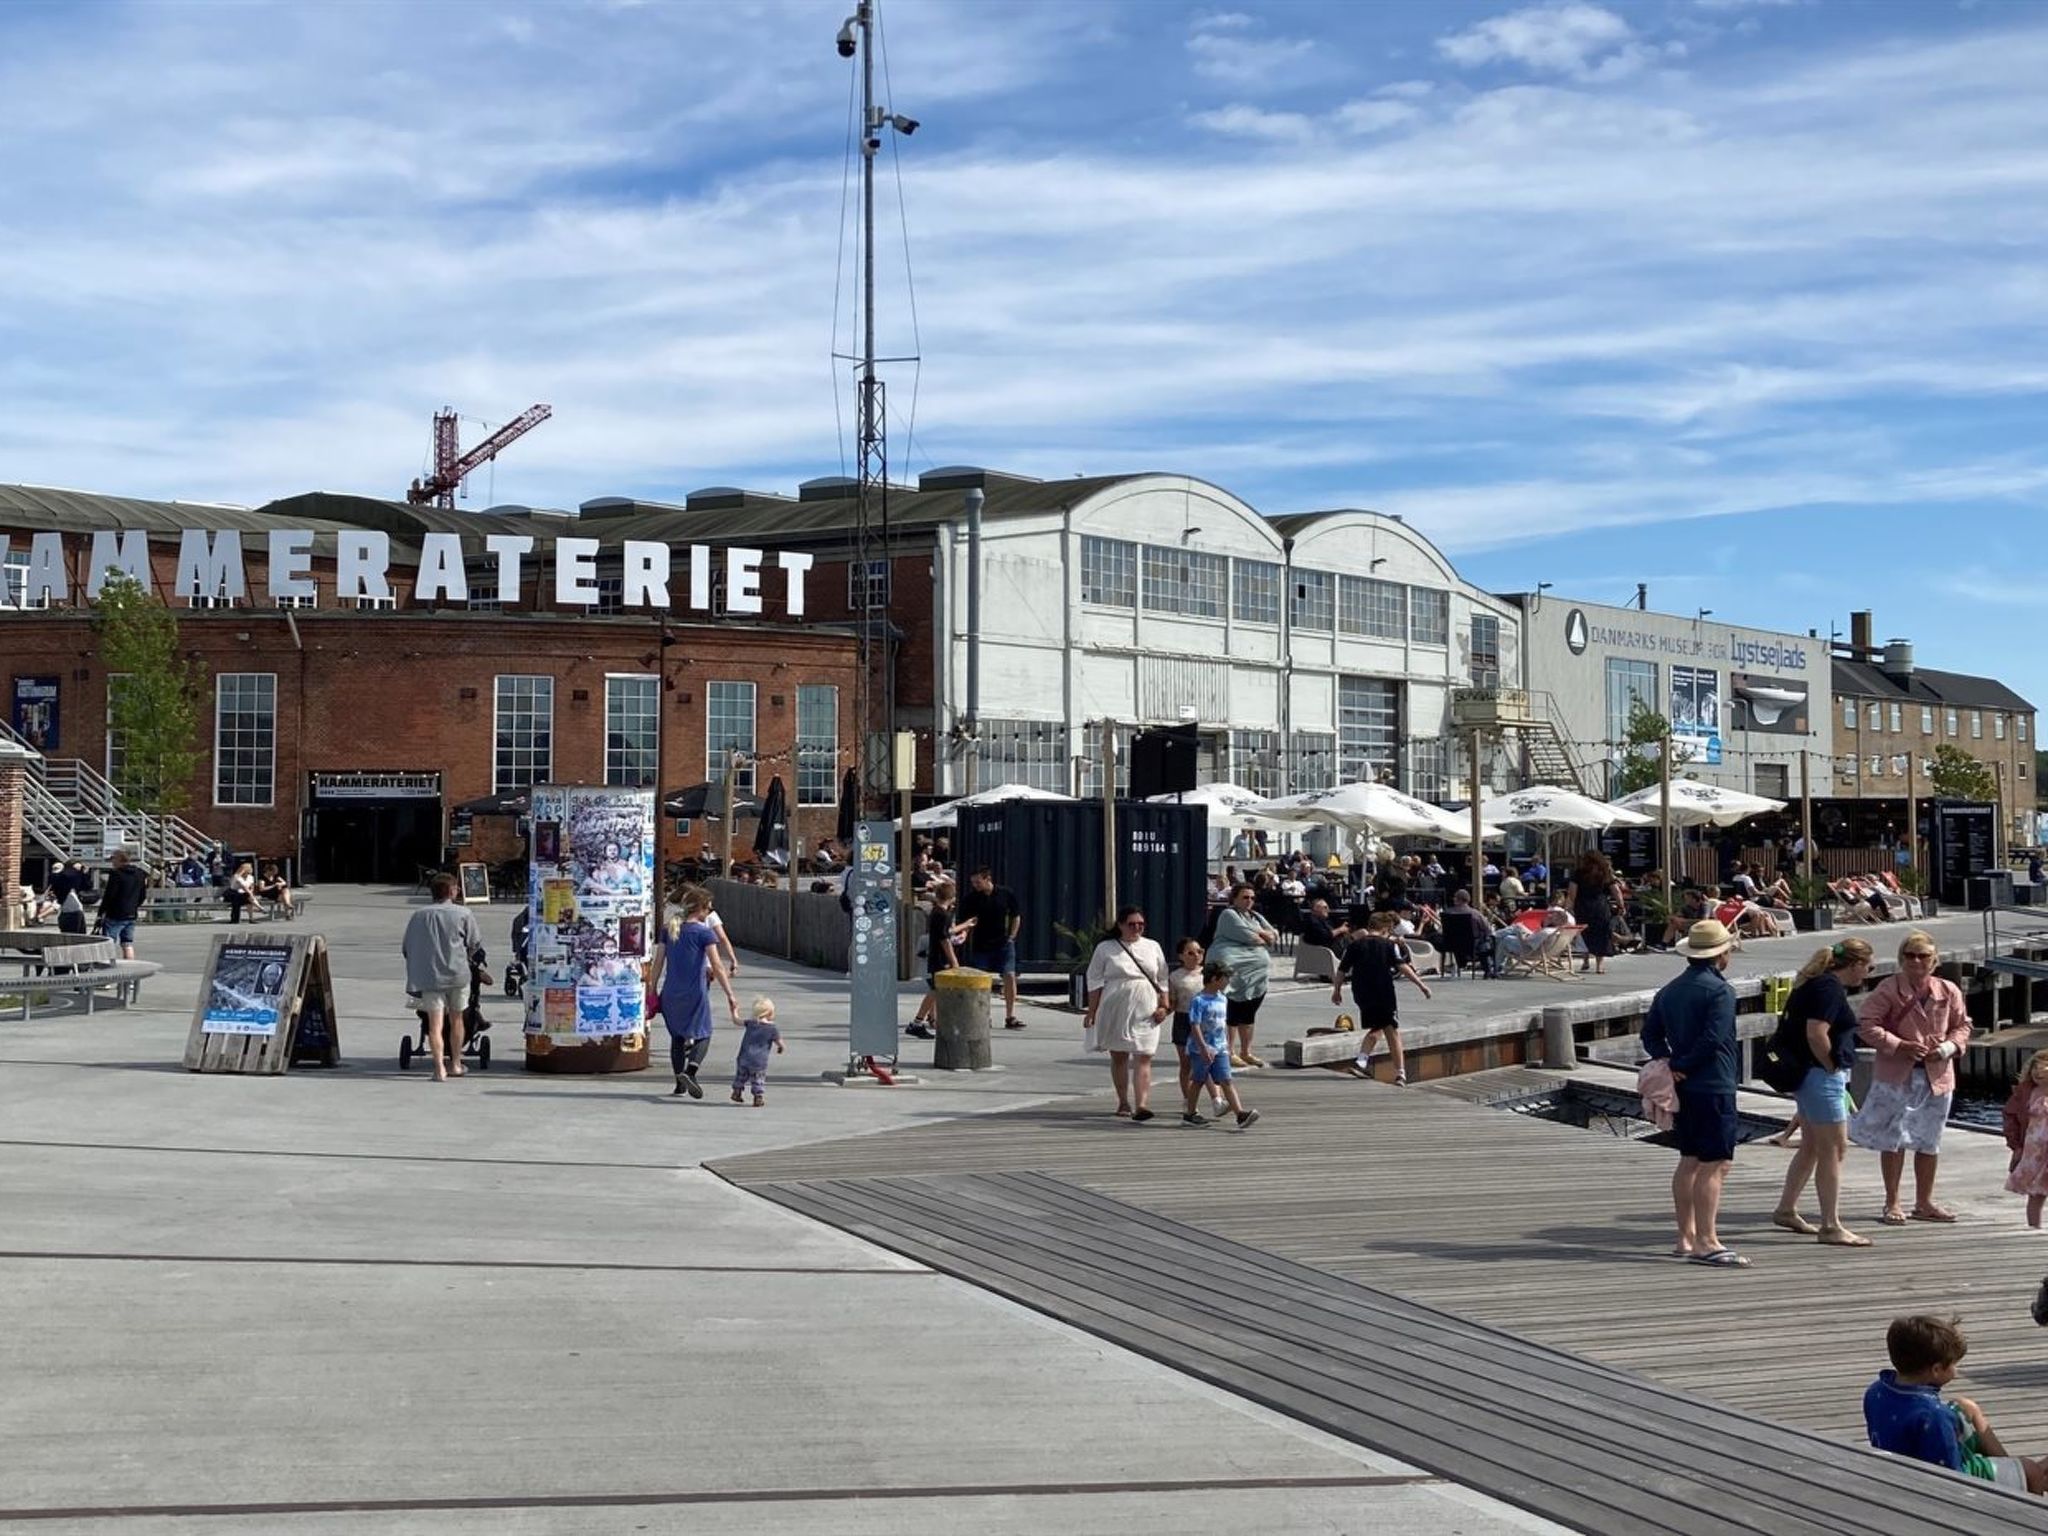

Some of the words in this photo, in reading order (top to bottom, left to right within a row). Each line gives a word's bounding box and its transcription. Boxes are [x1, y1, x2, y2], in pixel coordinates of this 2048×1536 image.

[0, 529, 813, 615] AMMERATERIET
[1591, 626, 1656, 650] DANMARKS
[1730, 633, 1807, 673] Lystsejlads
[320, 776, 434, 788] KAMMERATERIET
